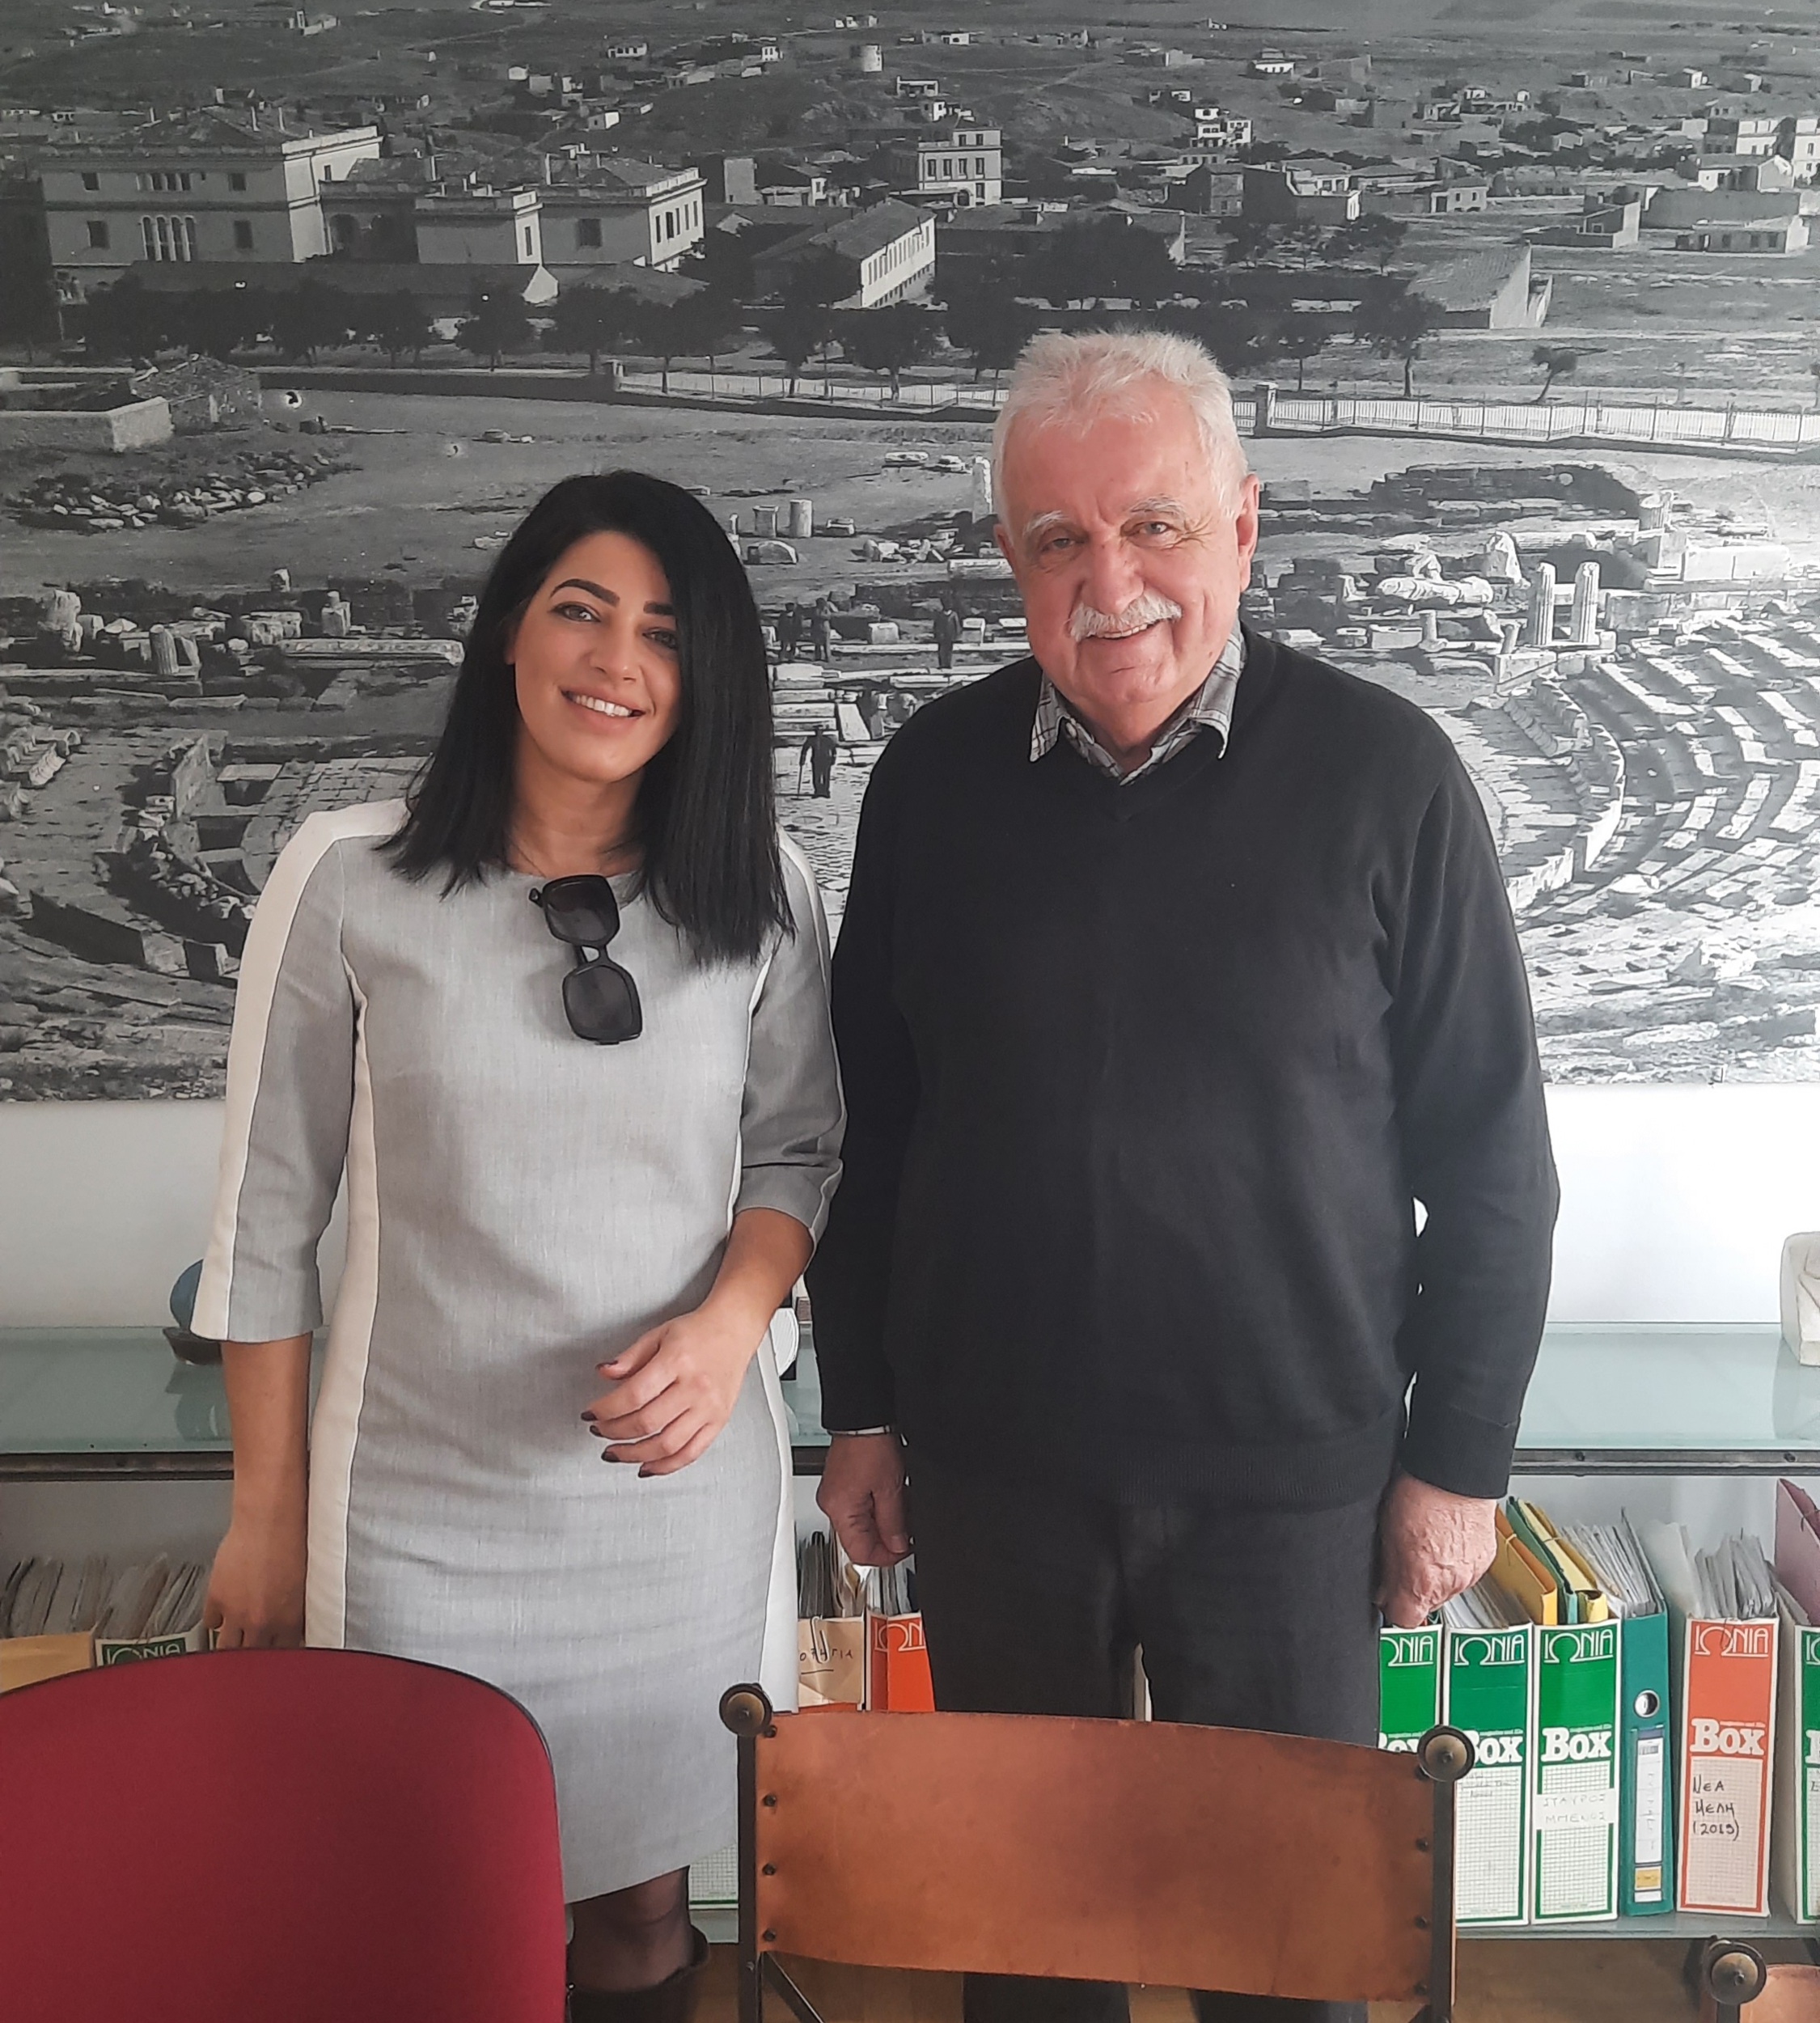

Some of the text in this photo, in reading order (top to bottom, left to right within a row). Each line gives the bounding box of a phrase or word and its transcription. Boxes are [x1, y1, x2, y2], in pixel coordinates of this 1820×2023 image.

[874, 1621, 926, 1652] ΙΩΝ
[1380, 1635, 1434, 1666] ΩΝΙΑ
[1541, 1727, 1612, 1762] Box
[1690, 1718, 1765, 1755] Box
